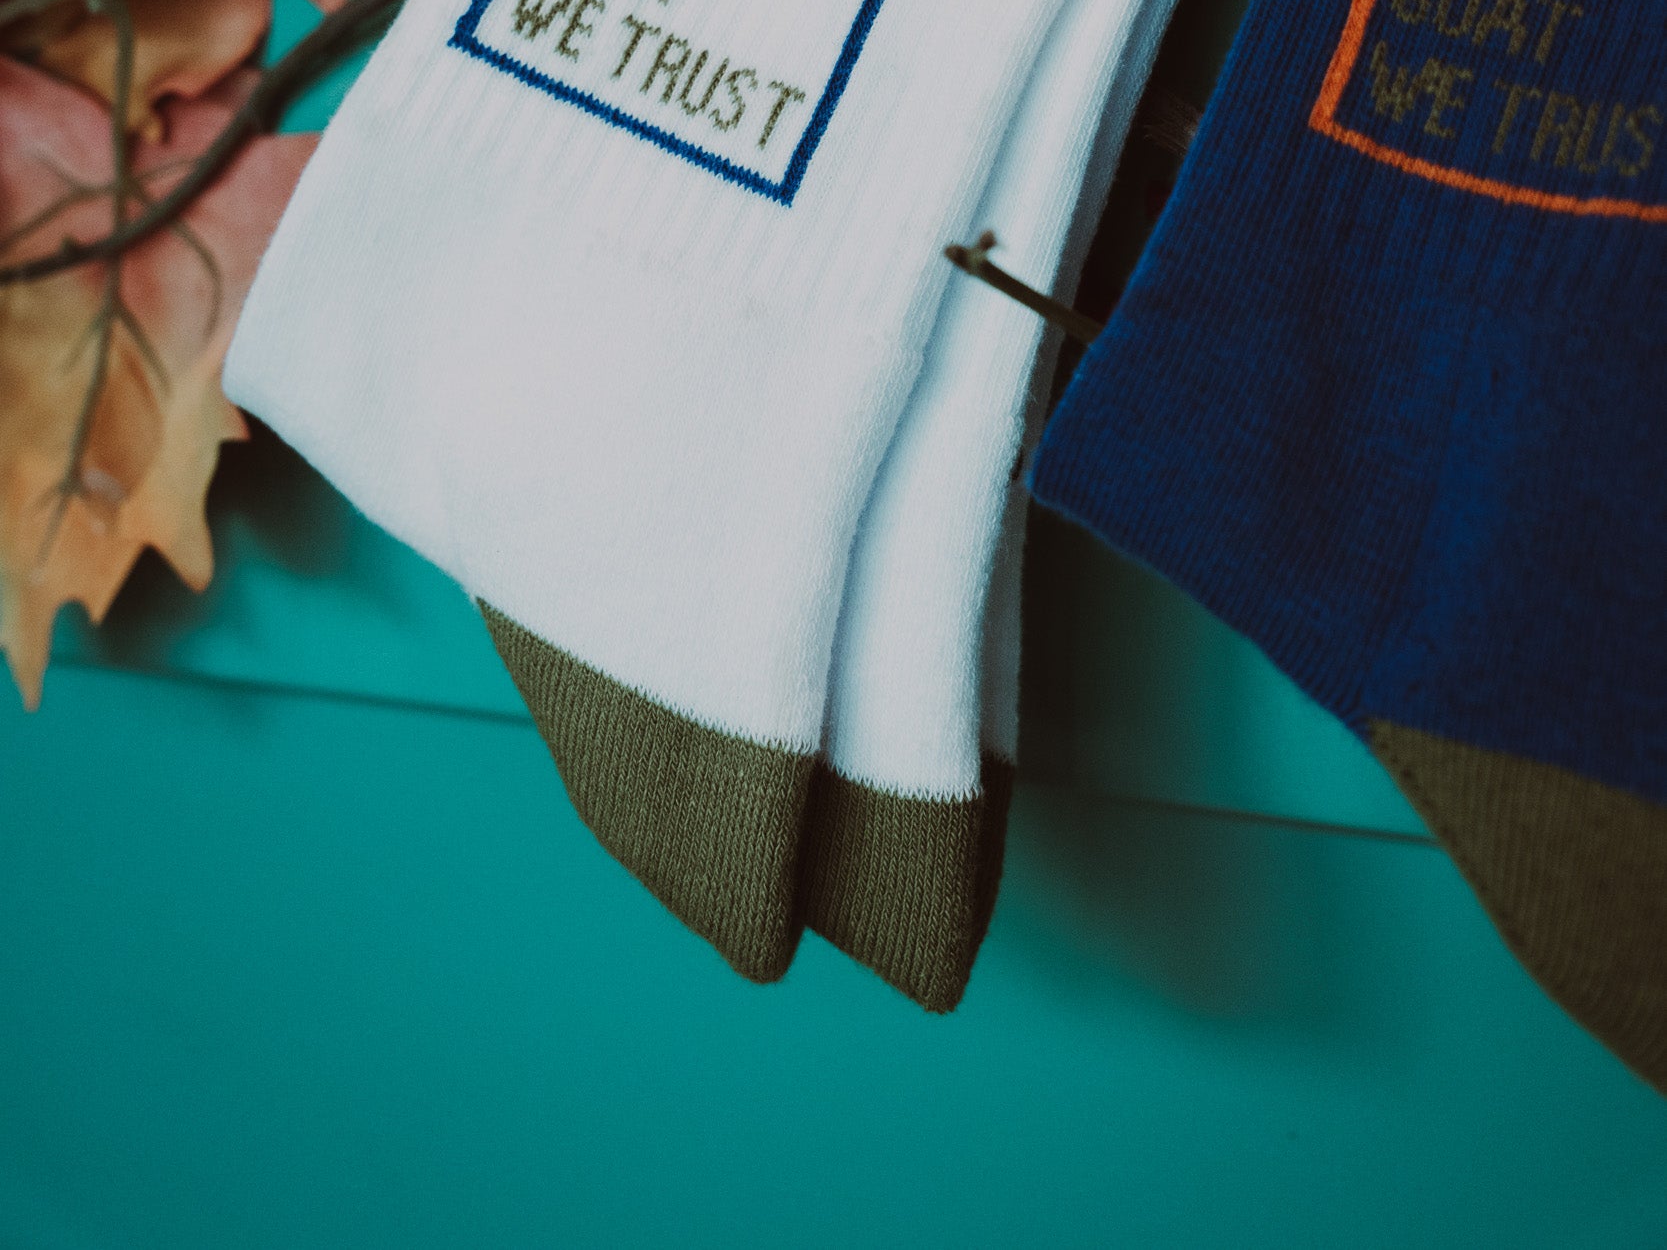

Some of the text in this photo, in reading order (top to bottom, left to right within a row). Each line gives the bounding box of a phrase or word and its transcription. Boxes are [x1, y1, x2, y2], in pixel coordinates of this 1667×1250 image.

[611, 14, 806, 150] TRUST
[1369, 40, 1667, 178] WE TRUS
